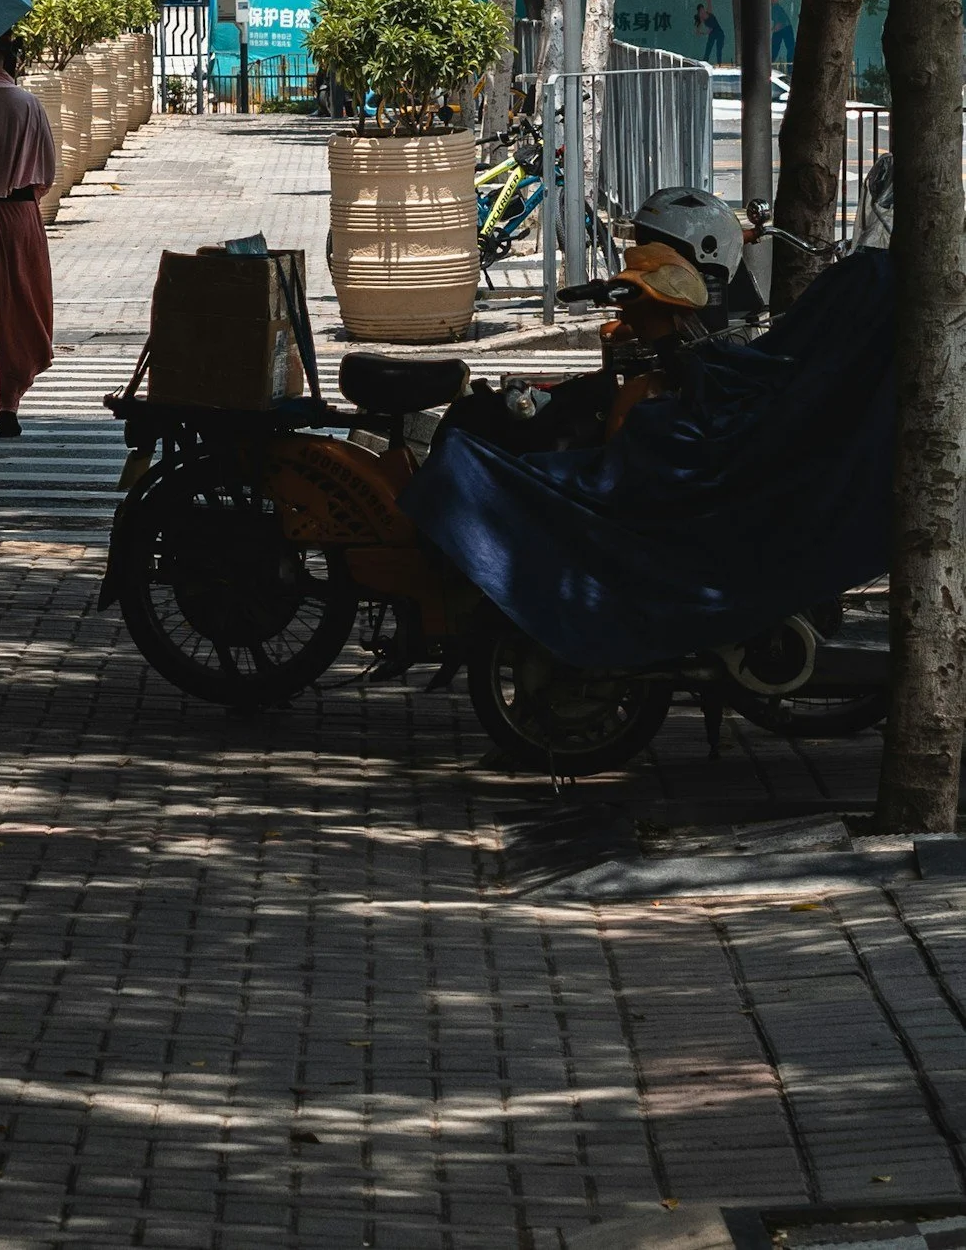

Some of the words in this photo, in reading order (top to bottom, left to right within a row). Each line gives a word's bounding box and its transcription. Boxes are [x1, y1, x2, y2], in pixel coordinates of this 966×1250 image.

[249, 7, 311, 28] 保护自然
[484, 173, 520, 235] ROCKRIDER
